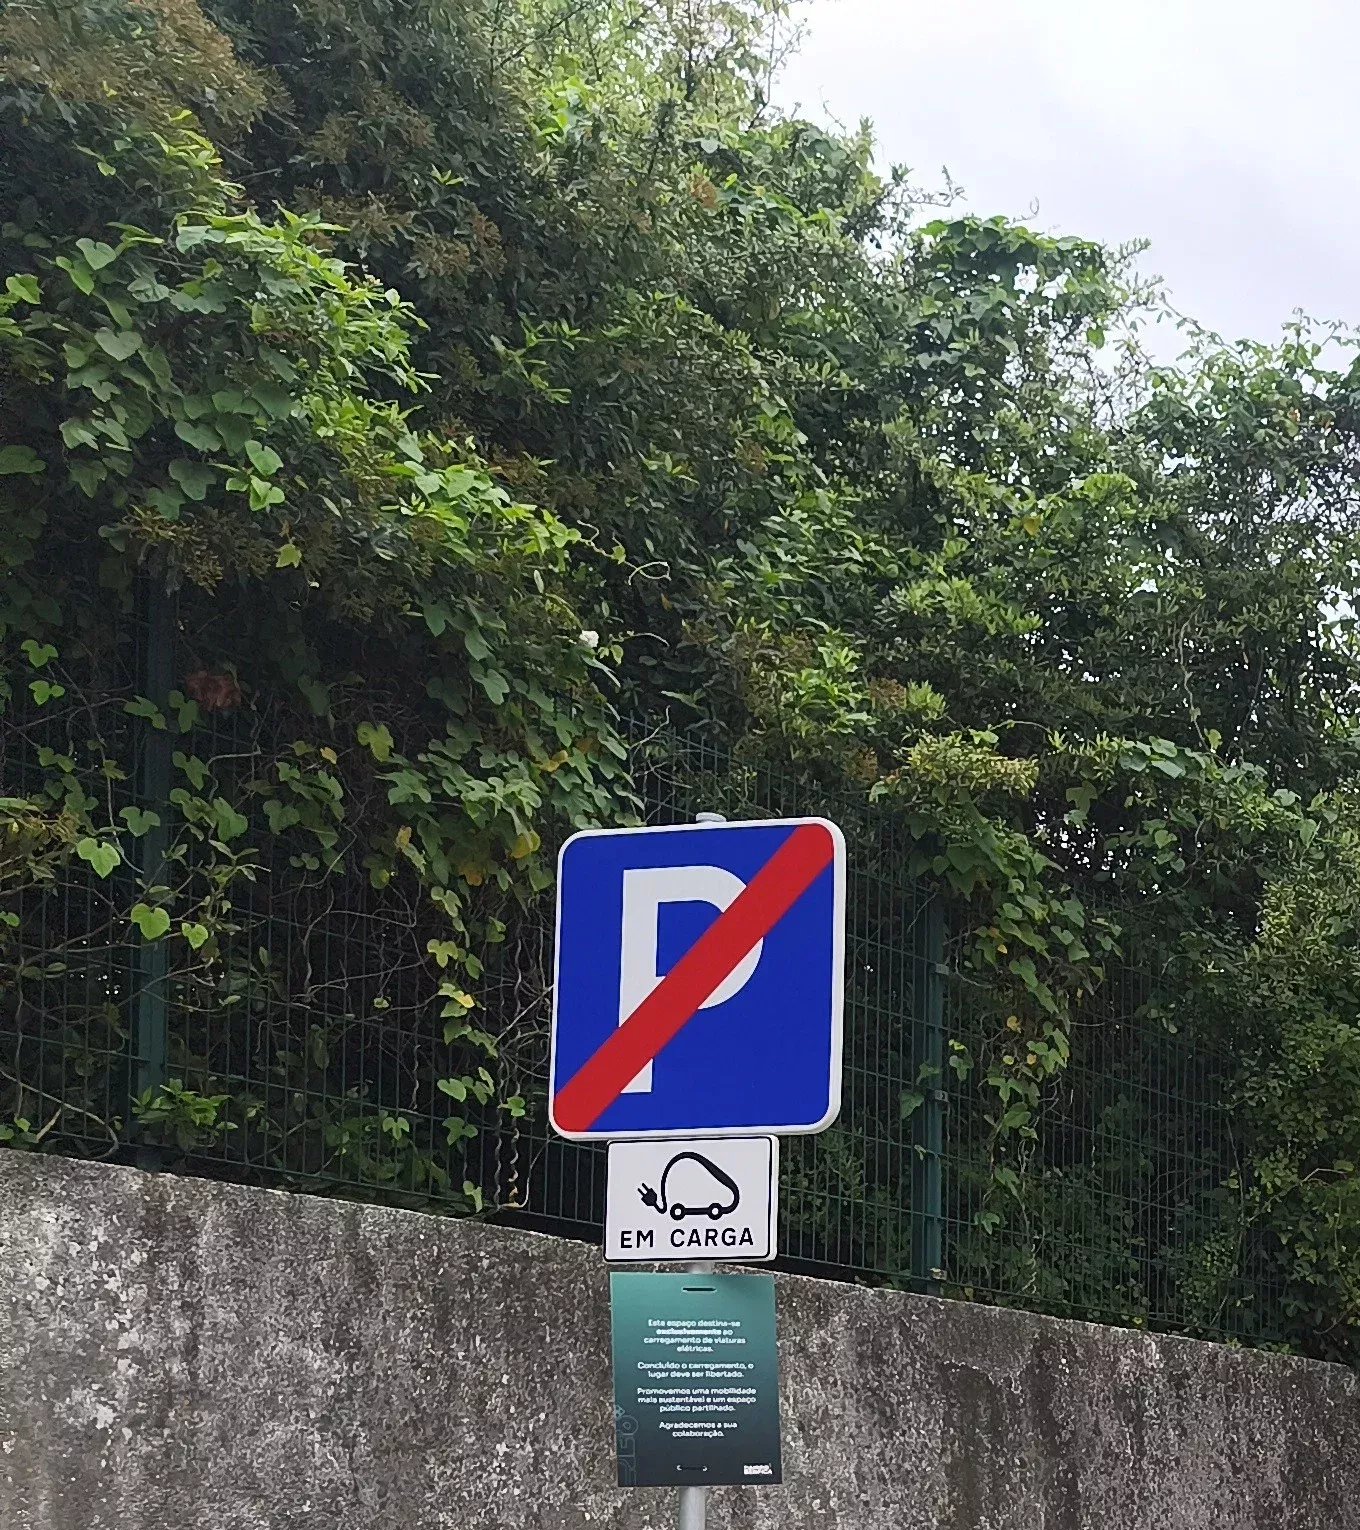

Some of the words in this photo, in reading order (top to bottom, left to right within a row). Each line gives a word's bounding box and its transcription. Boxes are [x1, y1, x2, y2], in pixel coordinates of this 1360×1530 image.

[619, 865, 763, 1094] P
[620, 1230, 654, 1249] EM
[670, 1227, 754, 1248] CARGA
[648, 1371, 669, 1379] lugar
